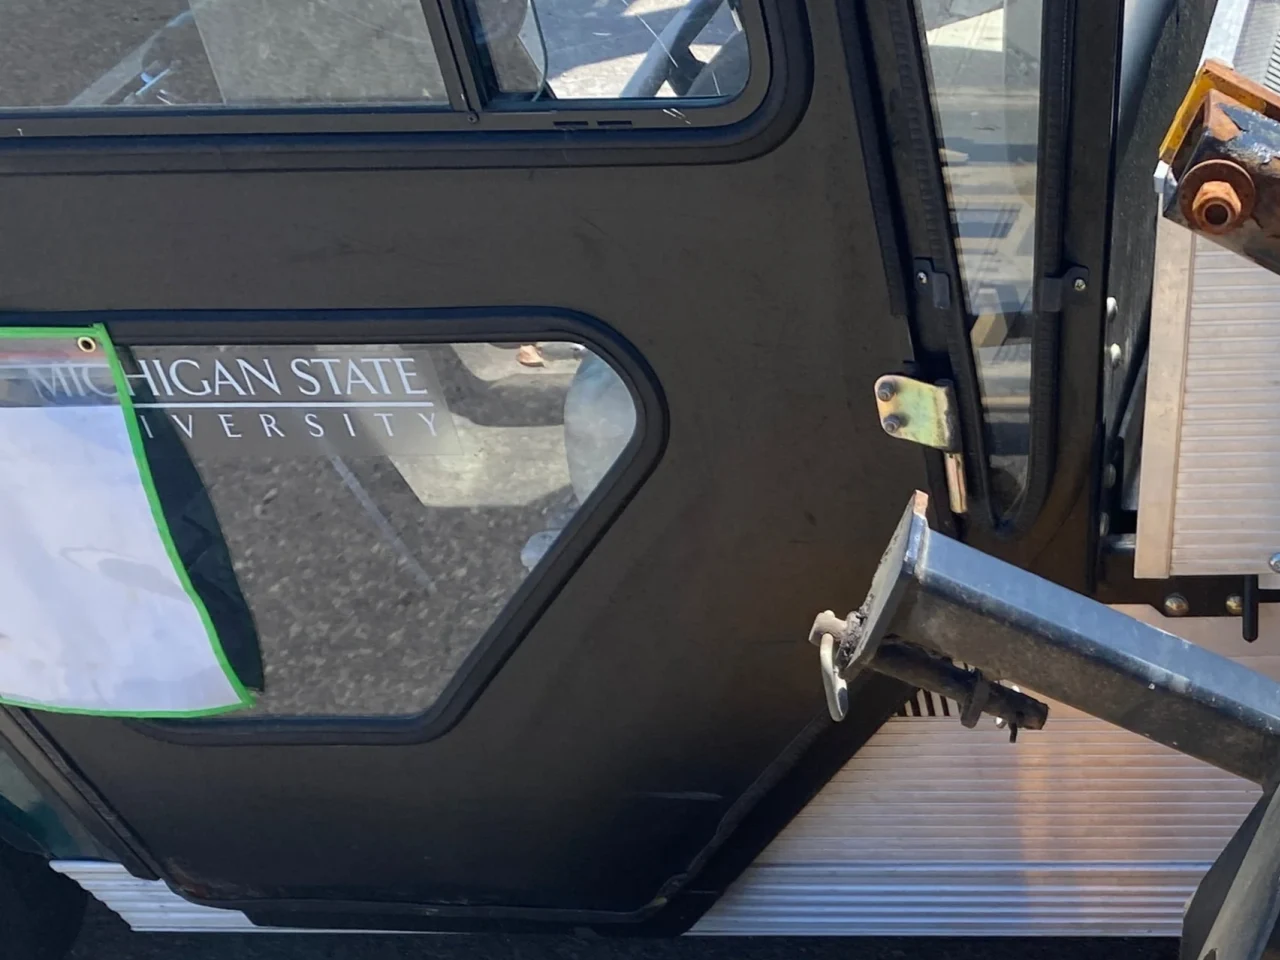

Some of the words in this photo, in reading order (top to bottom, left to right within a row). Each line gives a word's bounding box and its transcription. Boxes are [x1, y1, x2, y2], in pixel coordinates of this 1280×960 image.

[28, 357, 281, 398] MICHIGAN
[291, 357, 427, 396] STATE
[143, 412, 439, 439] IVERSITY
